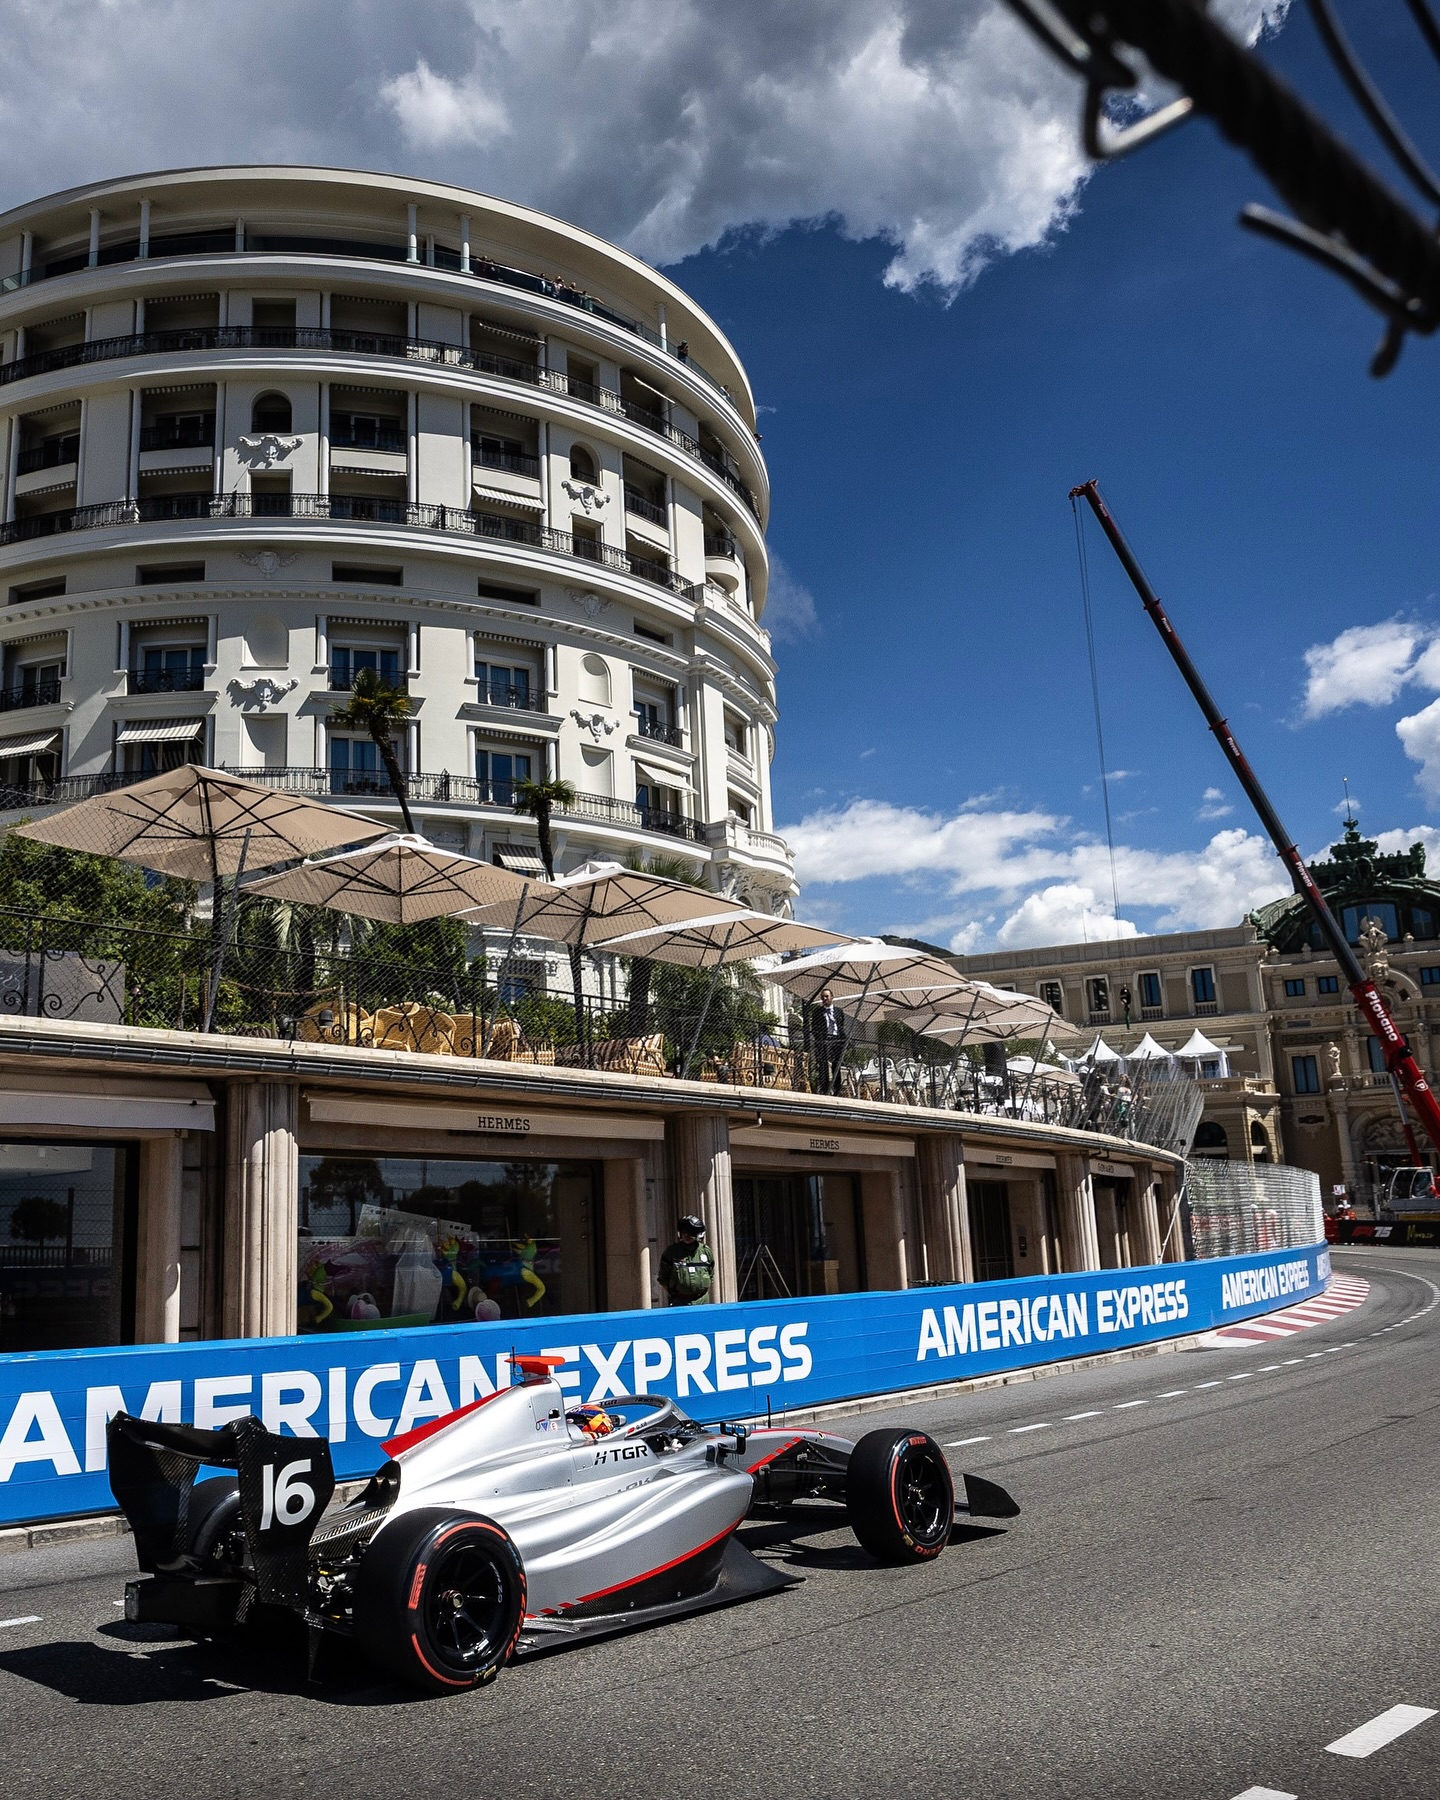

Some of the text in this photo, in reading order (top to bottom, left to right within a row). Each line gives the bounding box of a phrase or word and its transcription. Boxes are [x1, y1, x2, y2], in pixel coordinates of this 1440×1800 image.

[1365, 990, 1398, 1041] Piovano
[1221, 1266, 1279, 1309] AMERICAN
[1277, 1260, 1309, 1295] EXPRESS
[916, 1279, 1189, 1361] AMERICAN EXPRESS
[260, 1459, 315, 1530] 16
